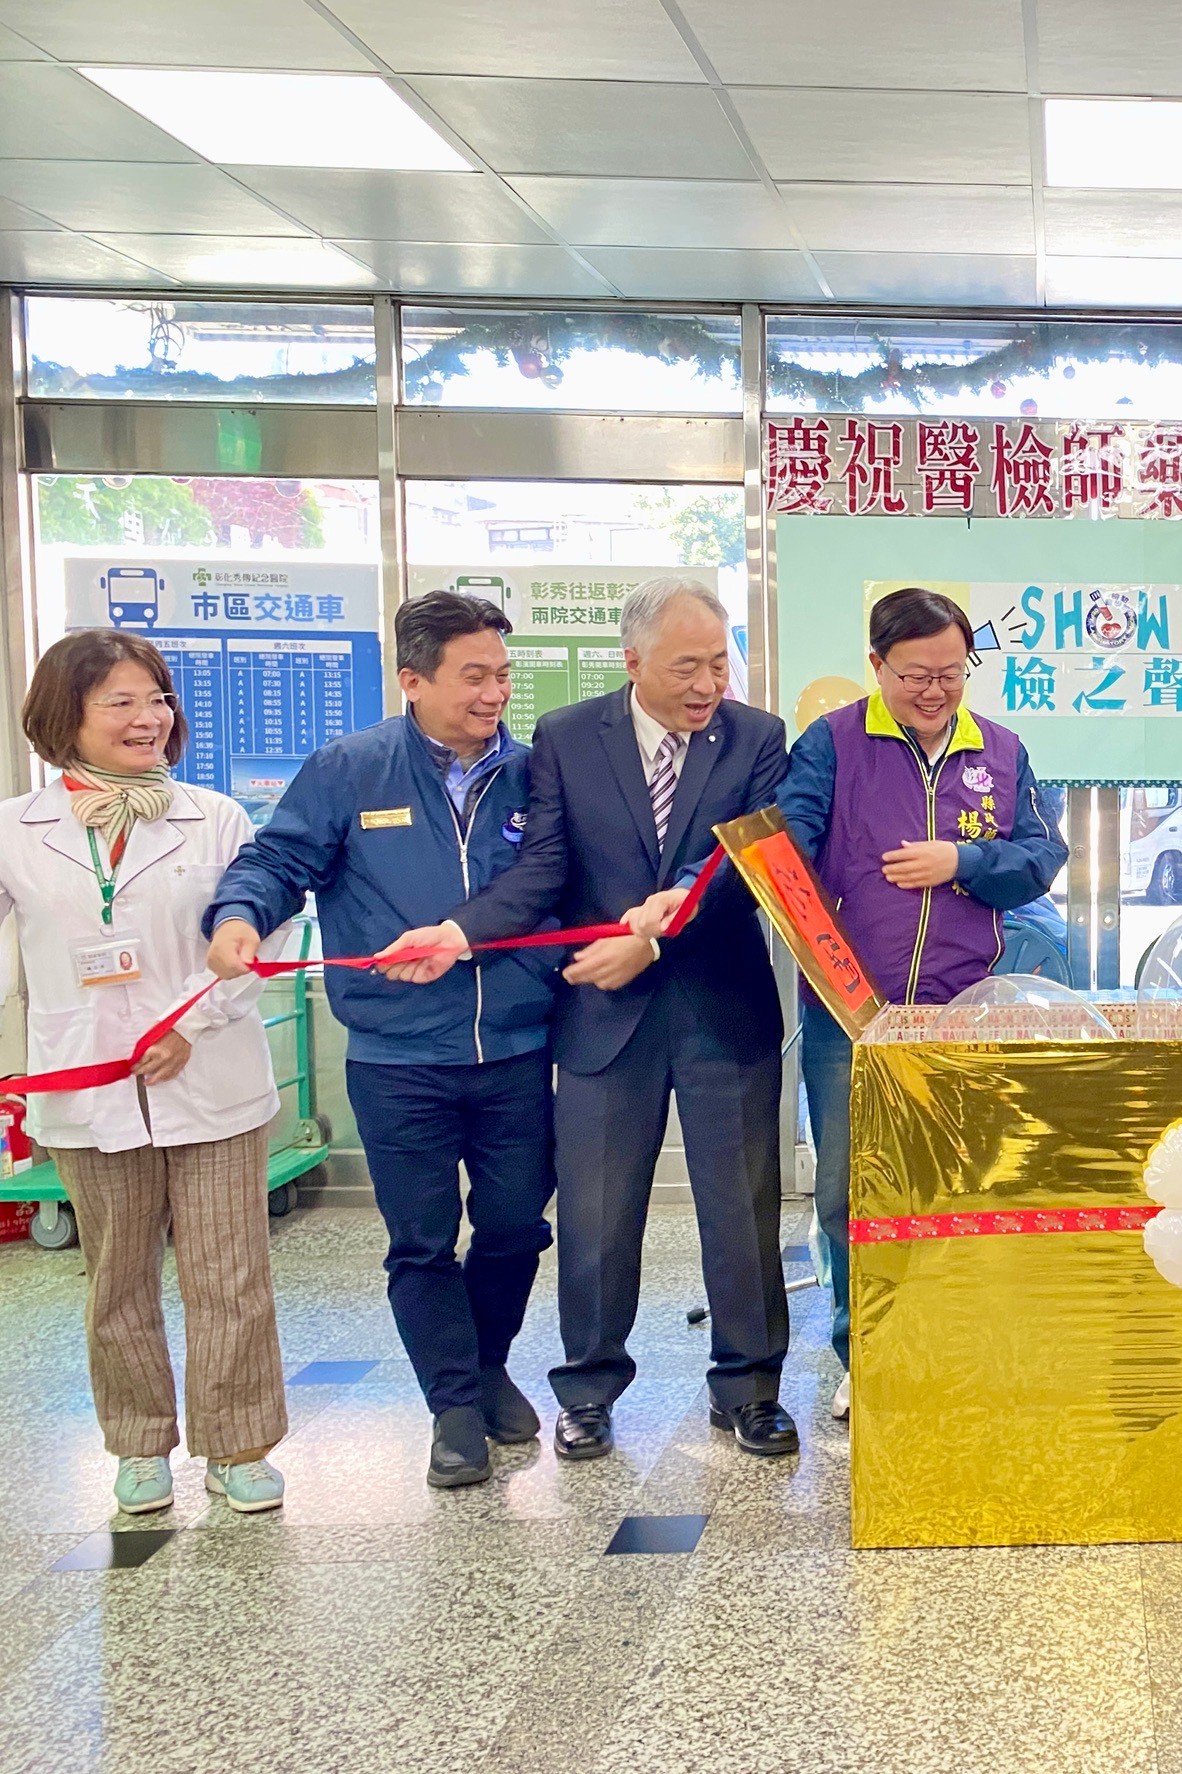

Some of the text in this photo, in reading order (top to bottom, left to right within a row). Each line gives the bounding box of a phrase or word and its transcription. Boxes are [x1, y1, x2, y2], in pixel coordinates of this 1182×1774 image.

[191, 591, 345, 623] 市區交通車
[510, 672, 534, 680] 07:00
[581, 681, 605, 689] 09:20
